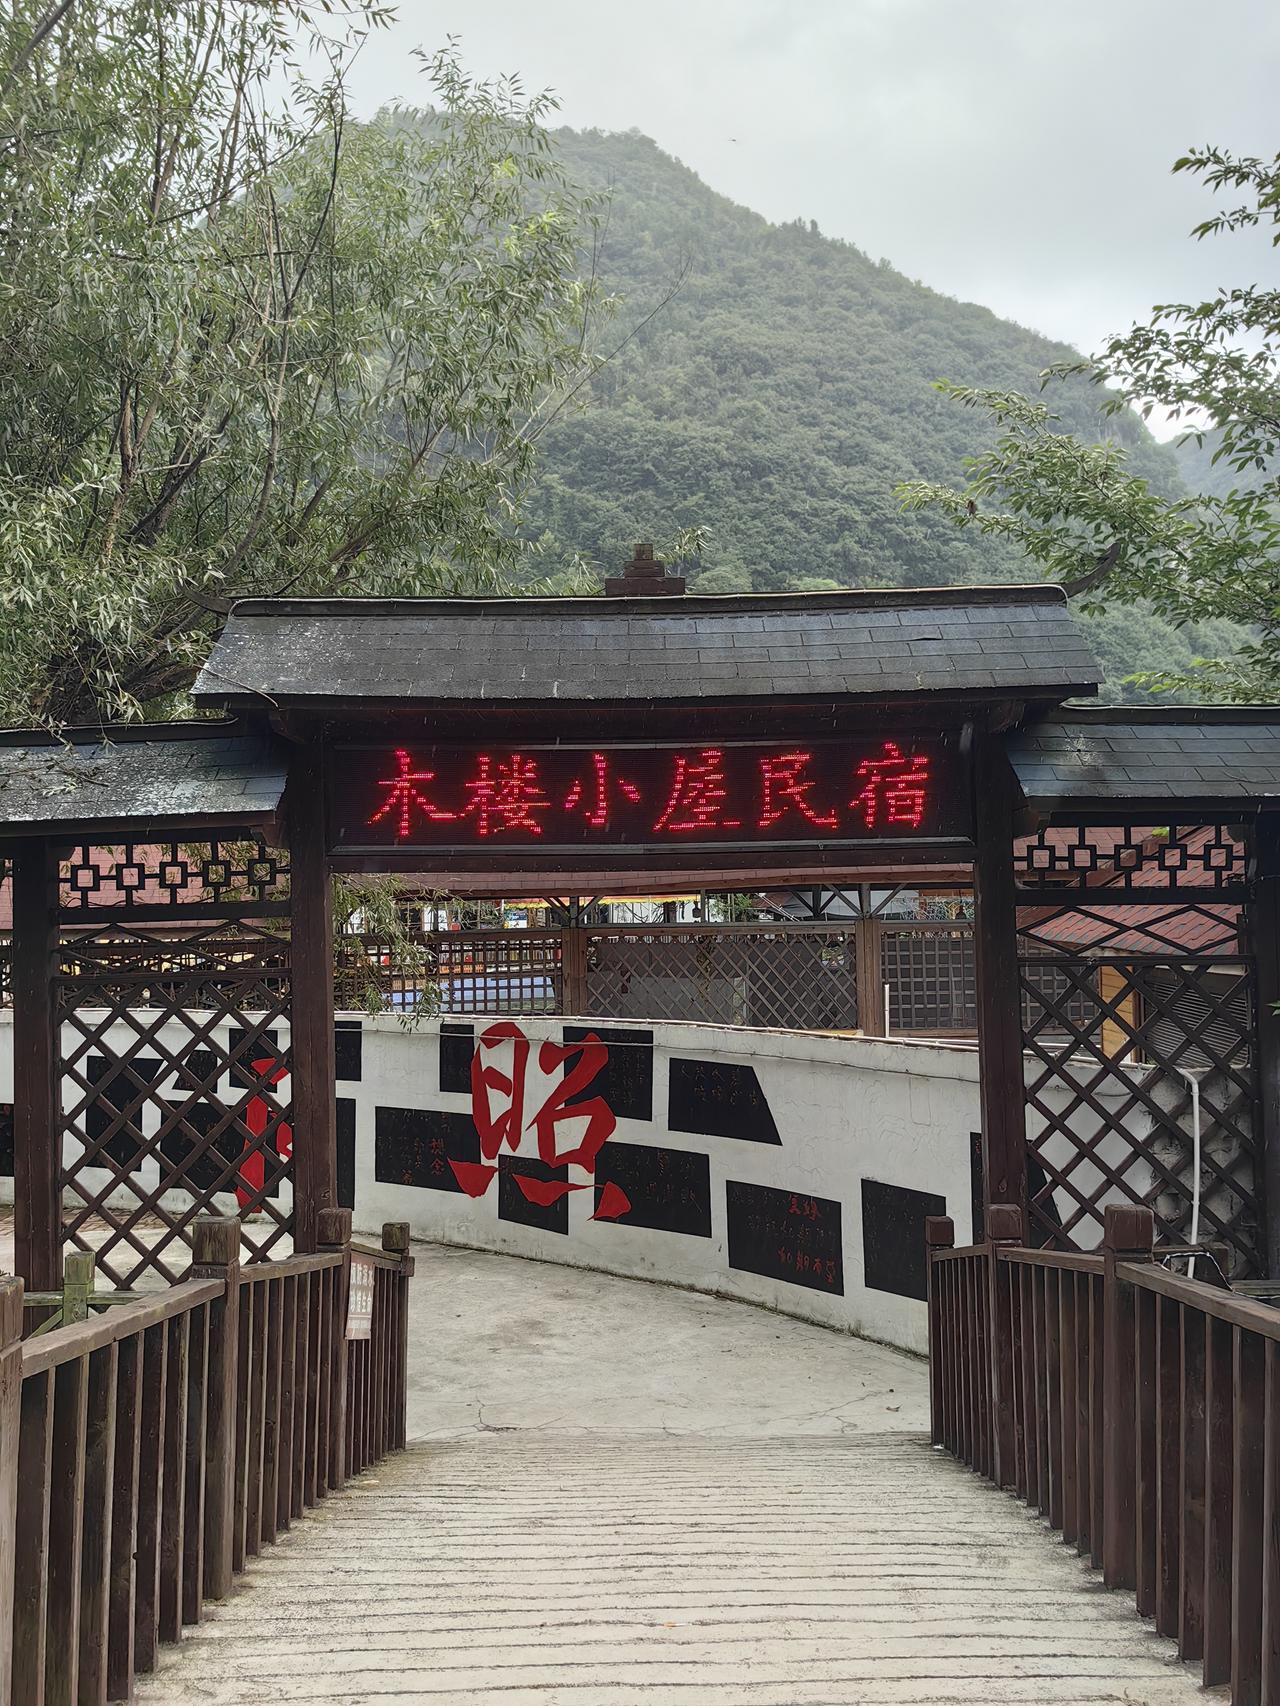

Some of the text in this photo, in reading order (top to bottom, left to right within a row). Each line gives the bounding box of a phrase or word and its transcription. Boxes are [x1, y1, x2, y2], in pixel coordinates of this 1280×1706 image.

[368, 741, 929, 838] 木楼小屋民宿
